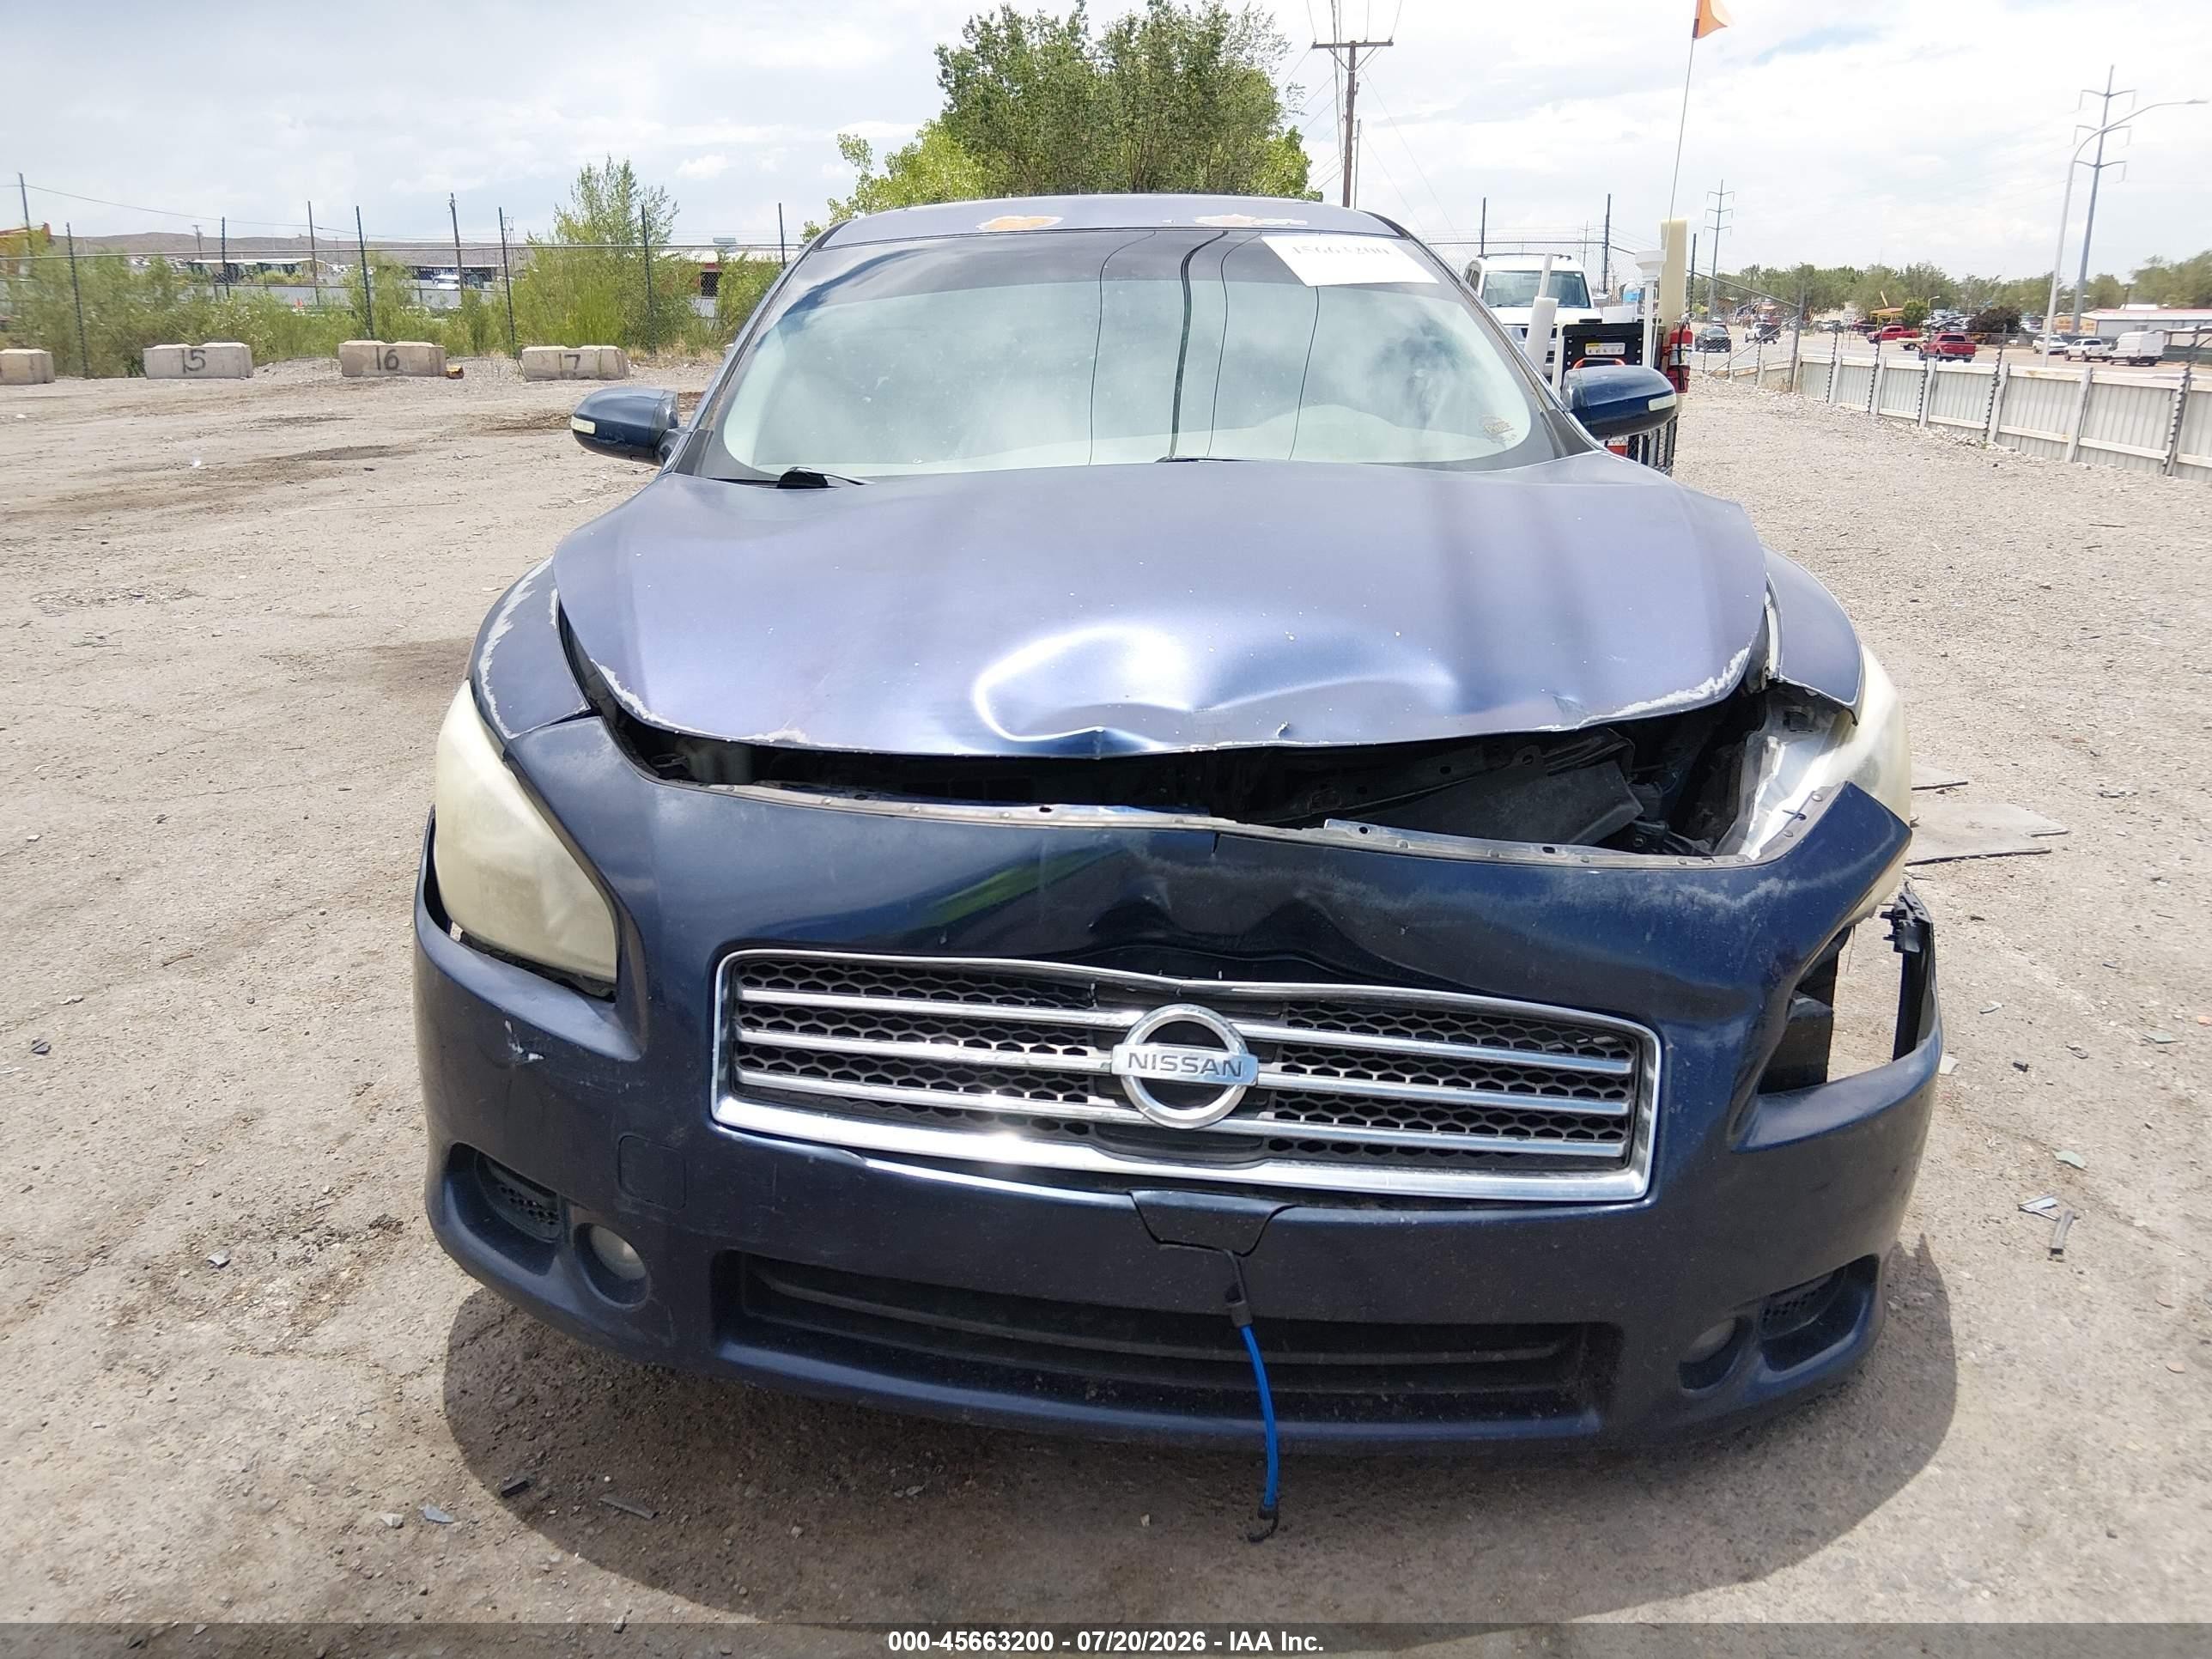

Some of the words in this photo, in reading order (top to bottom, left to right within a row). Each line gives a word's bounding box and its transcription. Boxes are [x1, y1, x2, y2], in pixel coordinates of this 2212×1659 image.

[182, 349, 206, 375] 15
[376, 345, 399, 372] 16
[558, 350, 580, 374] 17
[1127, 1052, 1243, 1078] NISSAN
